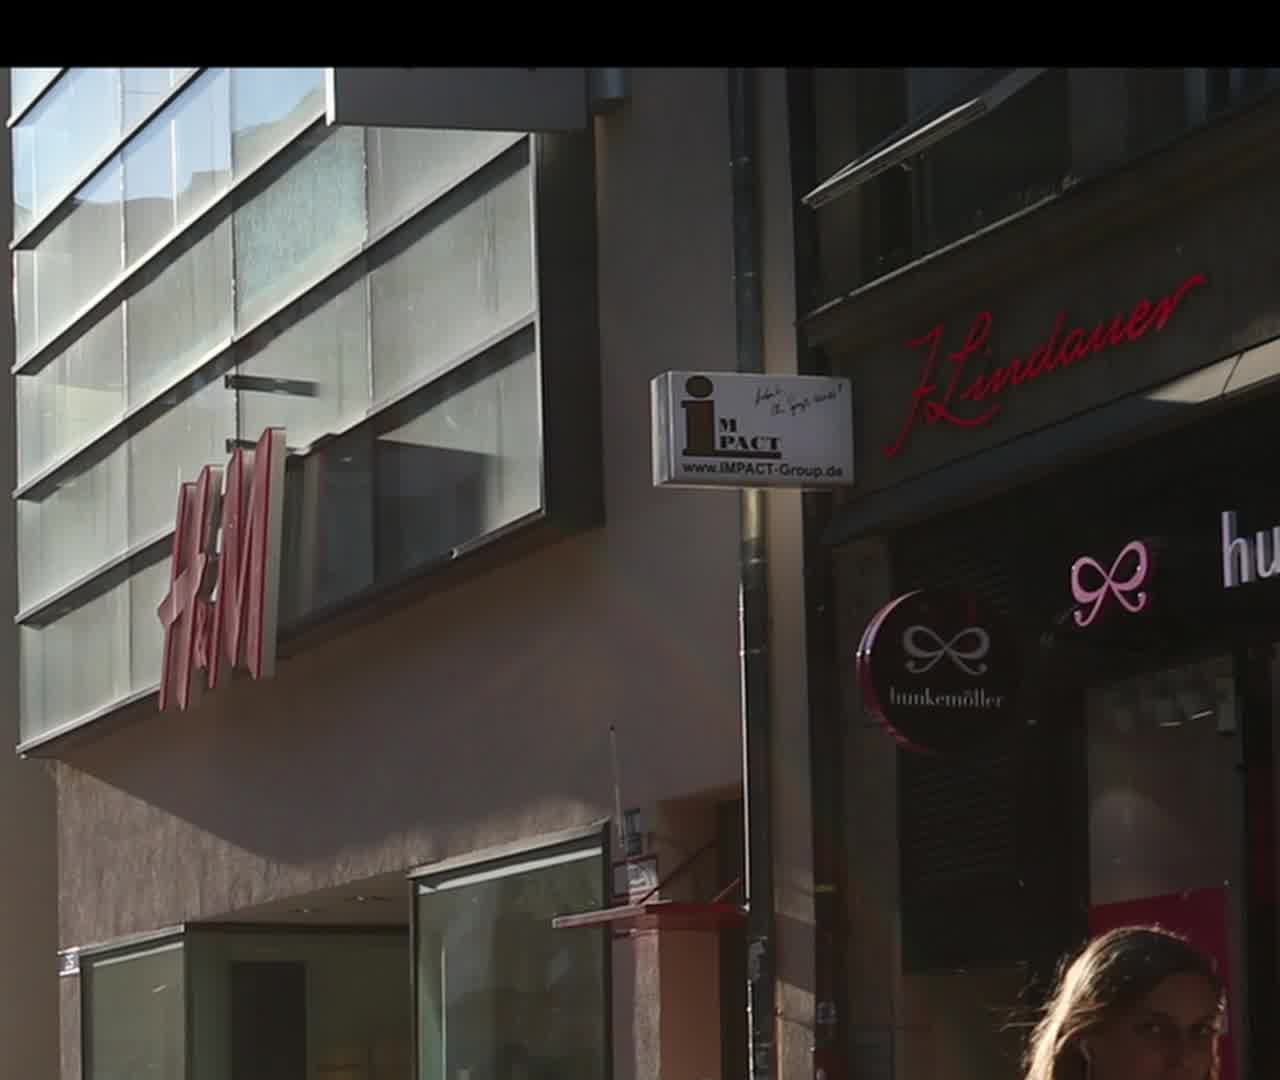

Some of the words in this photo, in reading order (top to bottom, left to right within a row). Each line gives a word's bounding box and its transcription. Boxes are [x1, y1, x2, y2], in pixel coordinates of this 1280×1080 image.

[682, 461, 844, 479] www.IMPACT-Group.de
[156, 427, 288, 712] H&M
[889, 685, 1005, 709] hunkemöller
